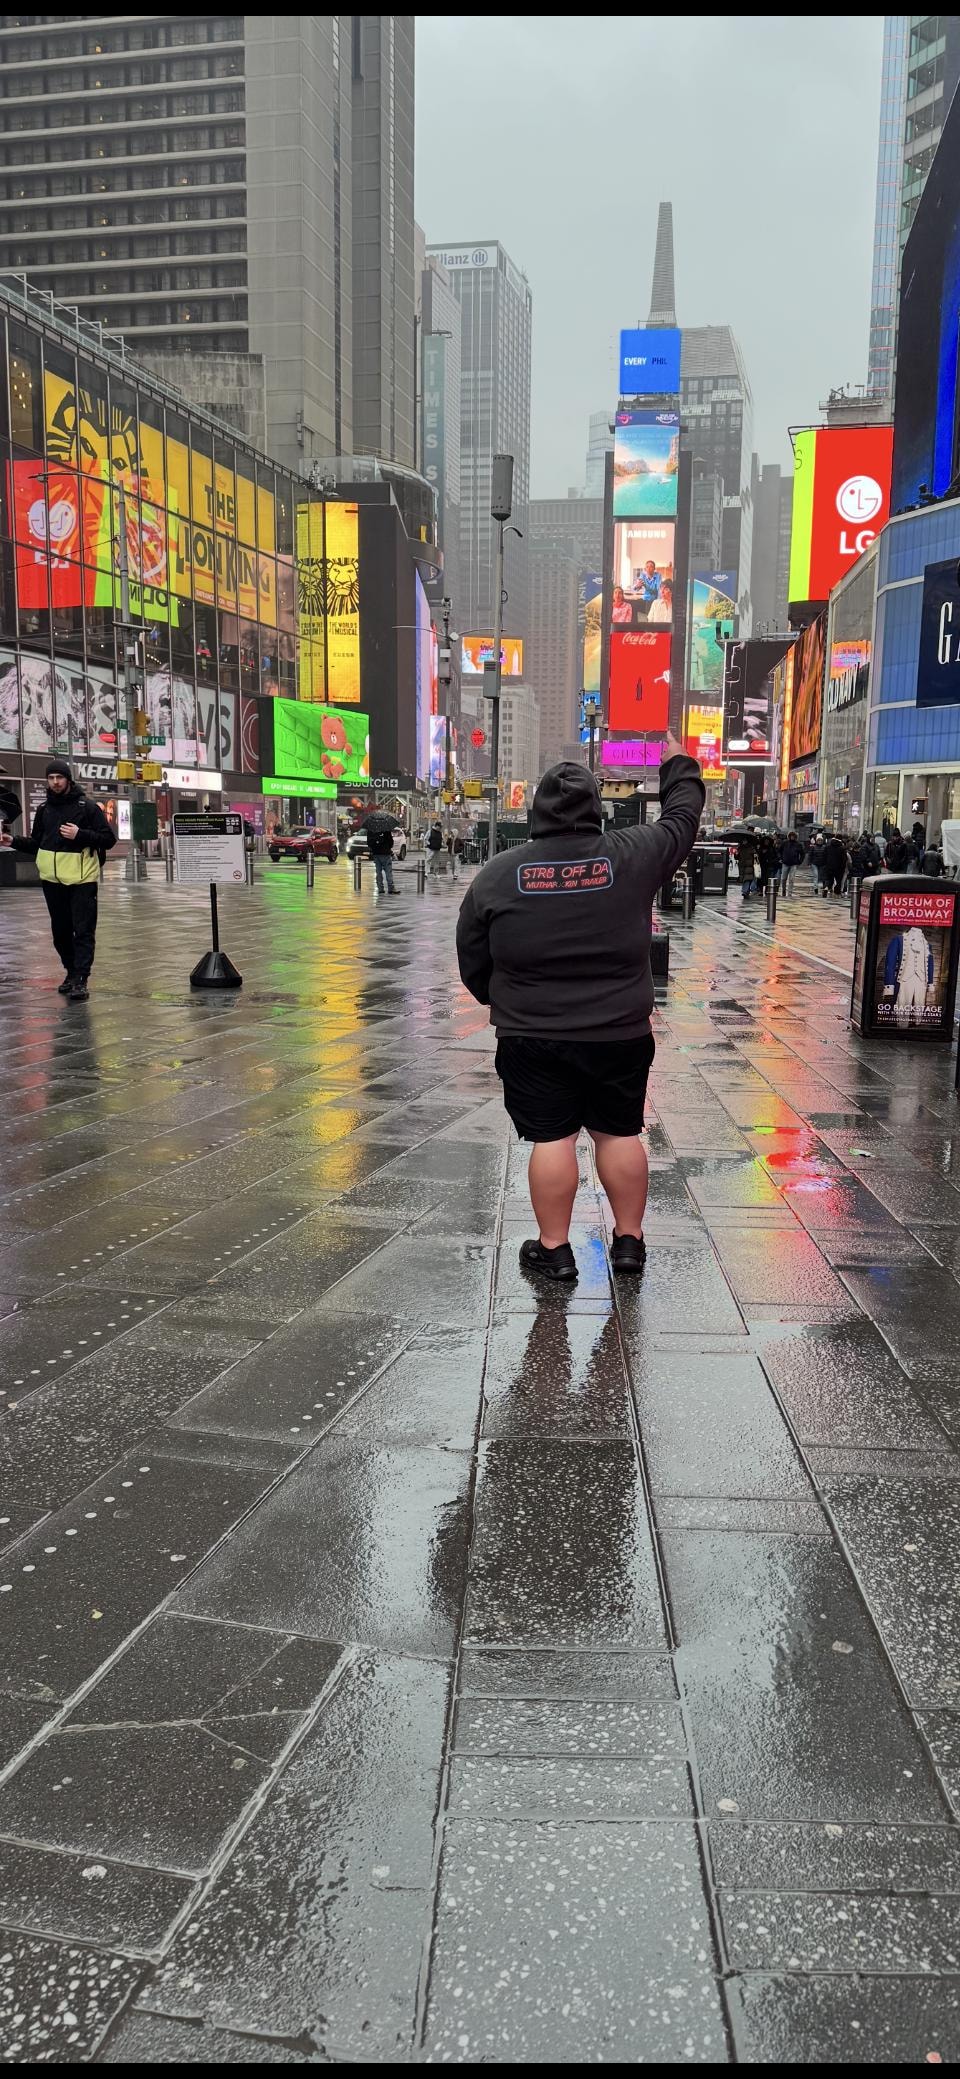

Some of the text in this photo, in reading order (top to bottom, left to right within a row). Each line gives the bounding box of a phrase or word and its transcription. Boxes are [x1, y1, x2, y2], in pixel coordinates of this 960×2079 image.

[624, 357, 647, 366] EVERY
[424, 350, 440, 449] TIMES
[204, 484, 235, 524] THE
[624, 529, 667, 539] AMSUNG
[839, 530, 875, 554] LG
[175, 507, 271, 594] LION KING
[522, 862, 609, 879] STR8 OFF DA
[581, 876, 607, 886] TRAILER
[884, 897, 951, 908] MUSEUM OF
[883, 908, 950, 919] BROADWAY
[877, 1003, 942, 1012] GO BACKSTAGE
